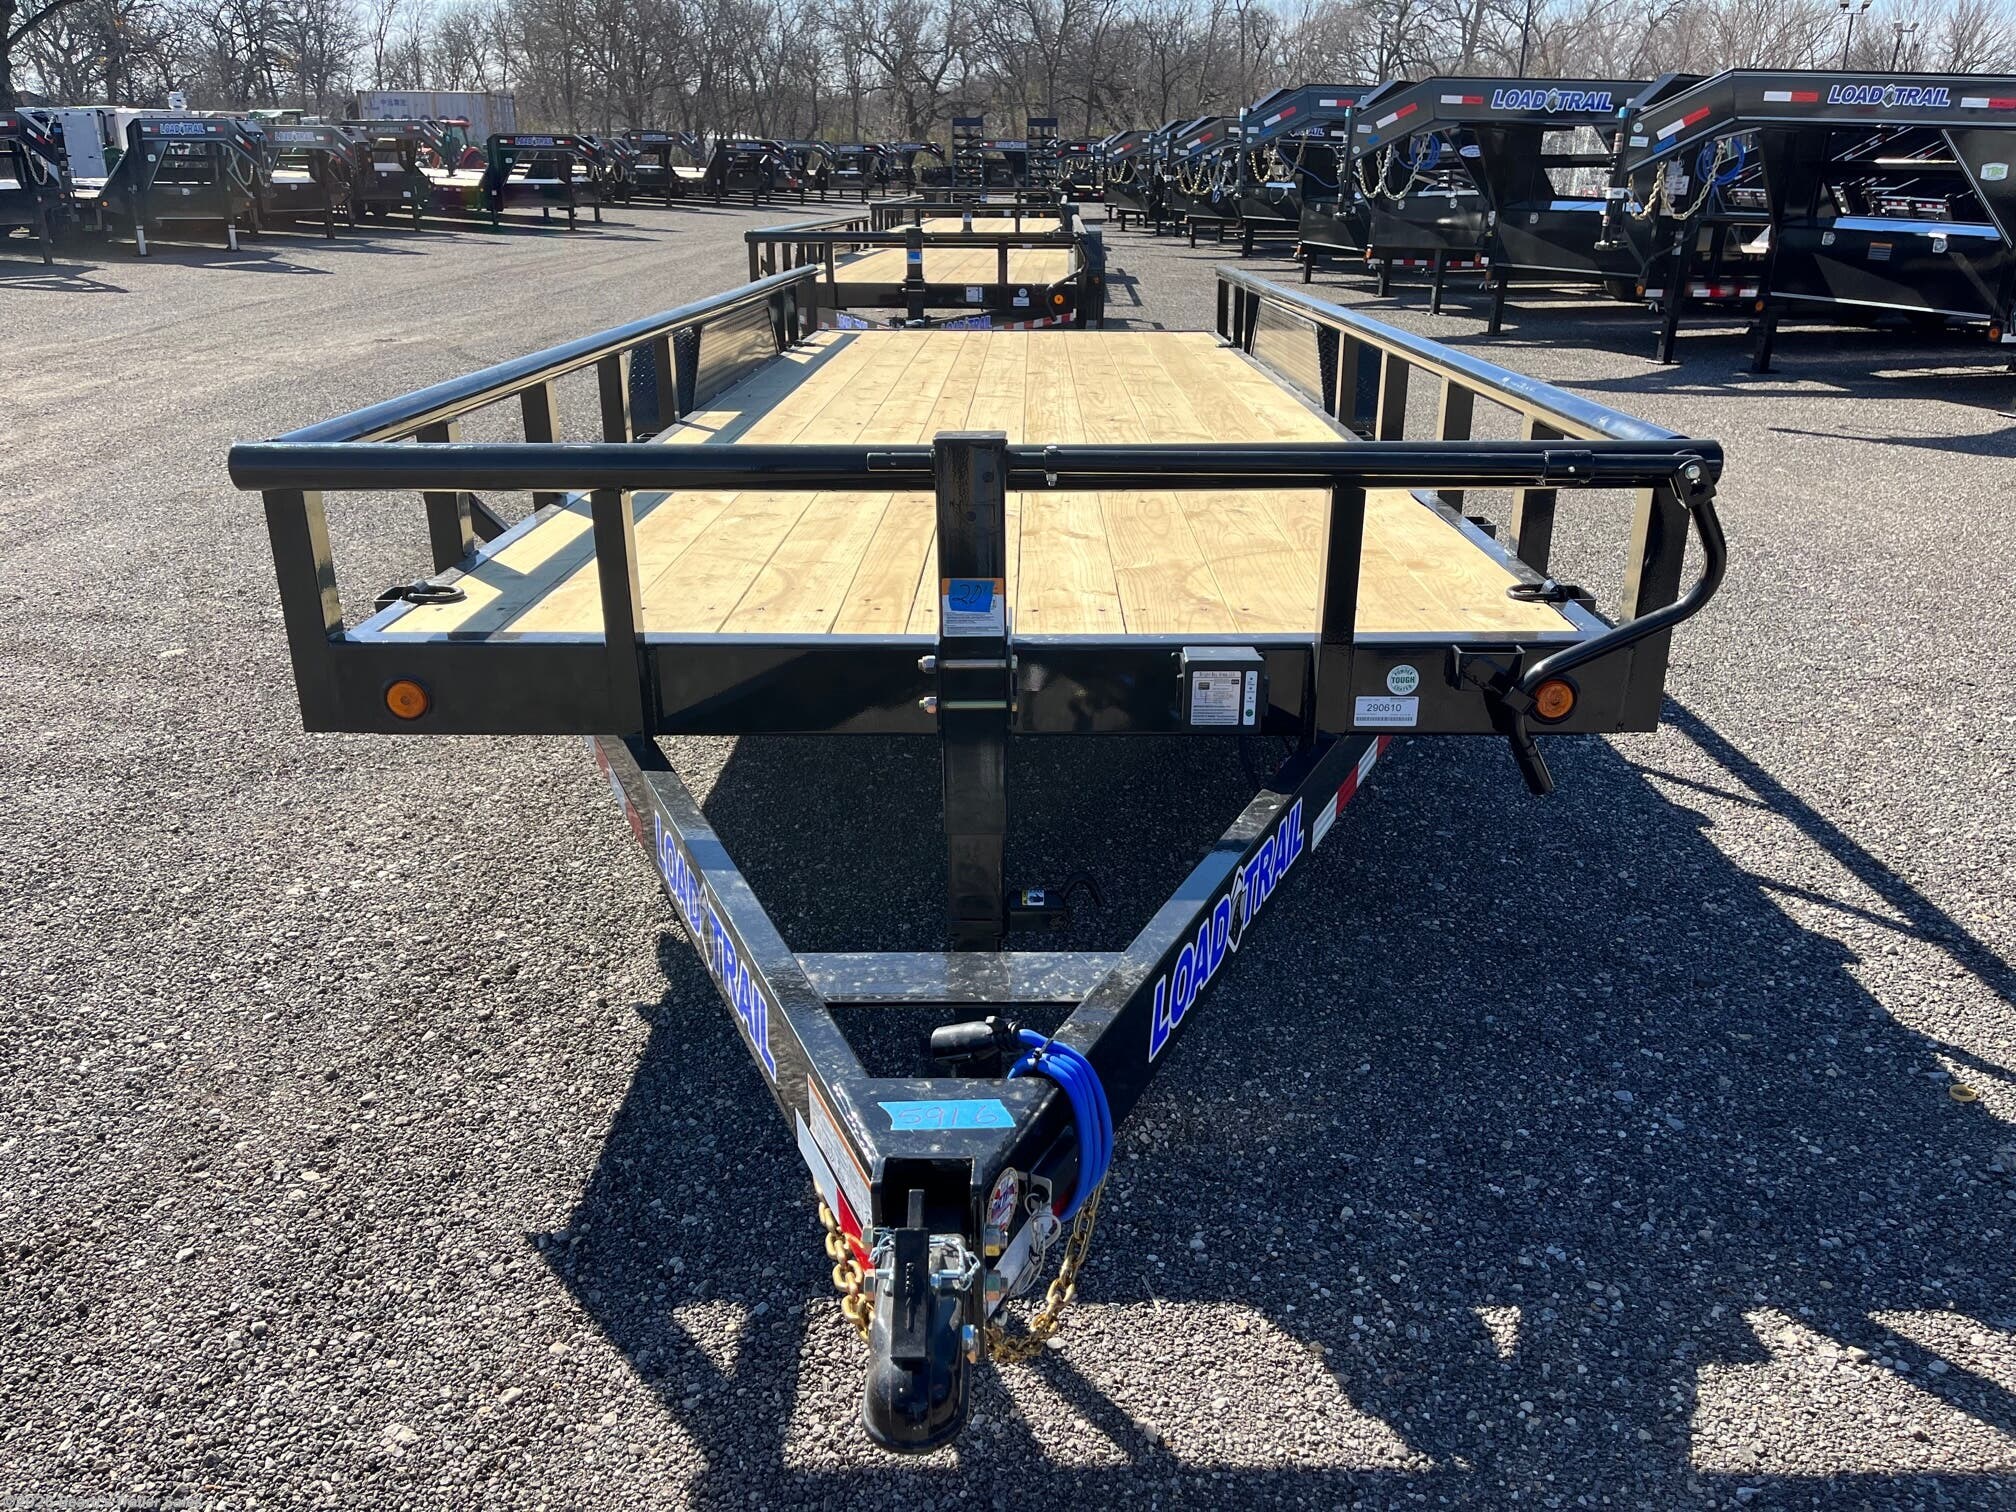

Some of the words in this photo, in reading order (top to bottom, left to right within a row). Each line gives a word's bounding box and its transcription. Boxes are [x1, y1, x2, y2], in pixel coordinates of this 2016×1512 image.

[1491, 89, 1548, 110] LOAD
[1555, 90, 1614, 112] TRAIL
[1826, 85, 1885, 105] LOAD
[1893, 86, 1952, 107] TRAIL
[160, 123, 180, 135] LOAD
[184, 123, 205, 135] TRAIL
[1391, 676, 1415, 684] TOUGH
[1366, 703, 1402, 712] 290610
[1149, 893, 1232, 1063] LOAD
[1242, 796, 1305, 931] TRAIL
[654, 809, 702, 938] LOAD
[707, 902, 776, 1084] TRAIL
